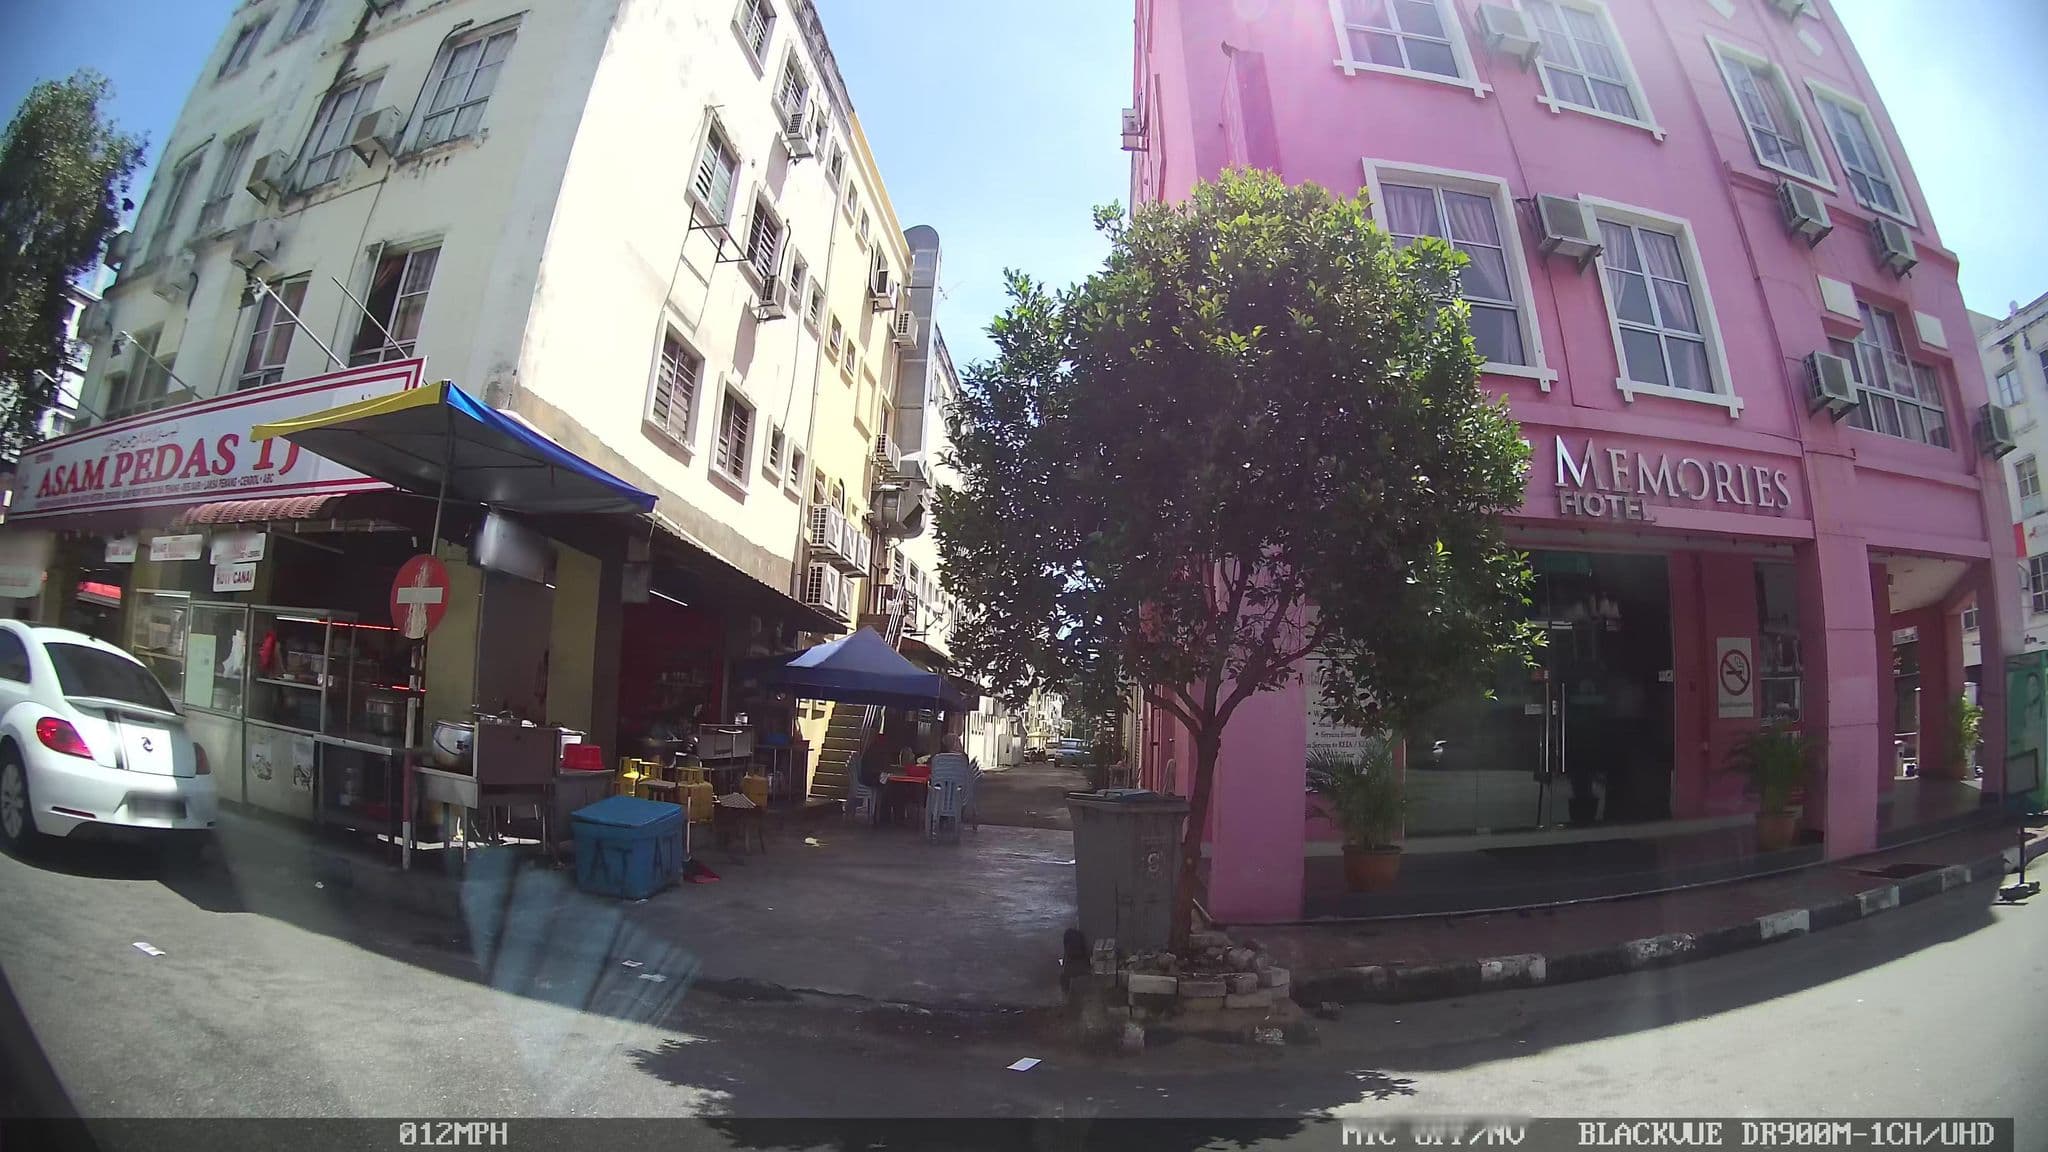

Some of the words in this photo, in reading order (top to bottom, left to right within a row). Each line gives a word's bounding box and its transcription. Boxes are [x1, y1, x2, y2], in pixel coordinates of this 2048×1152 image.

[36, 456, 110, 498] ASAM
[110, 433, 240, 487] PEDAS
[1555, 434, 1792, 511] MEMORIES
[1557, 489, 1656, 522] HOTEL
